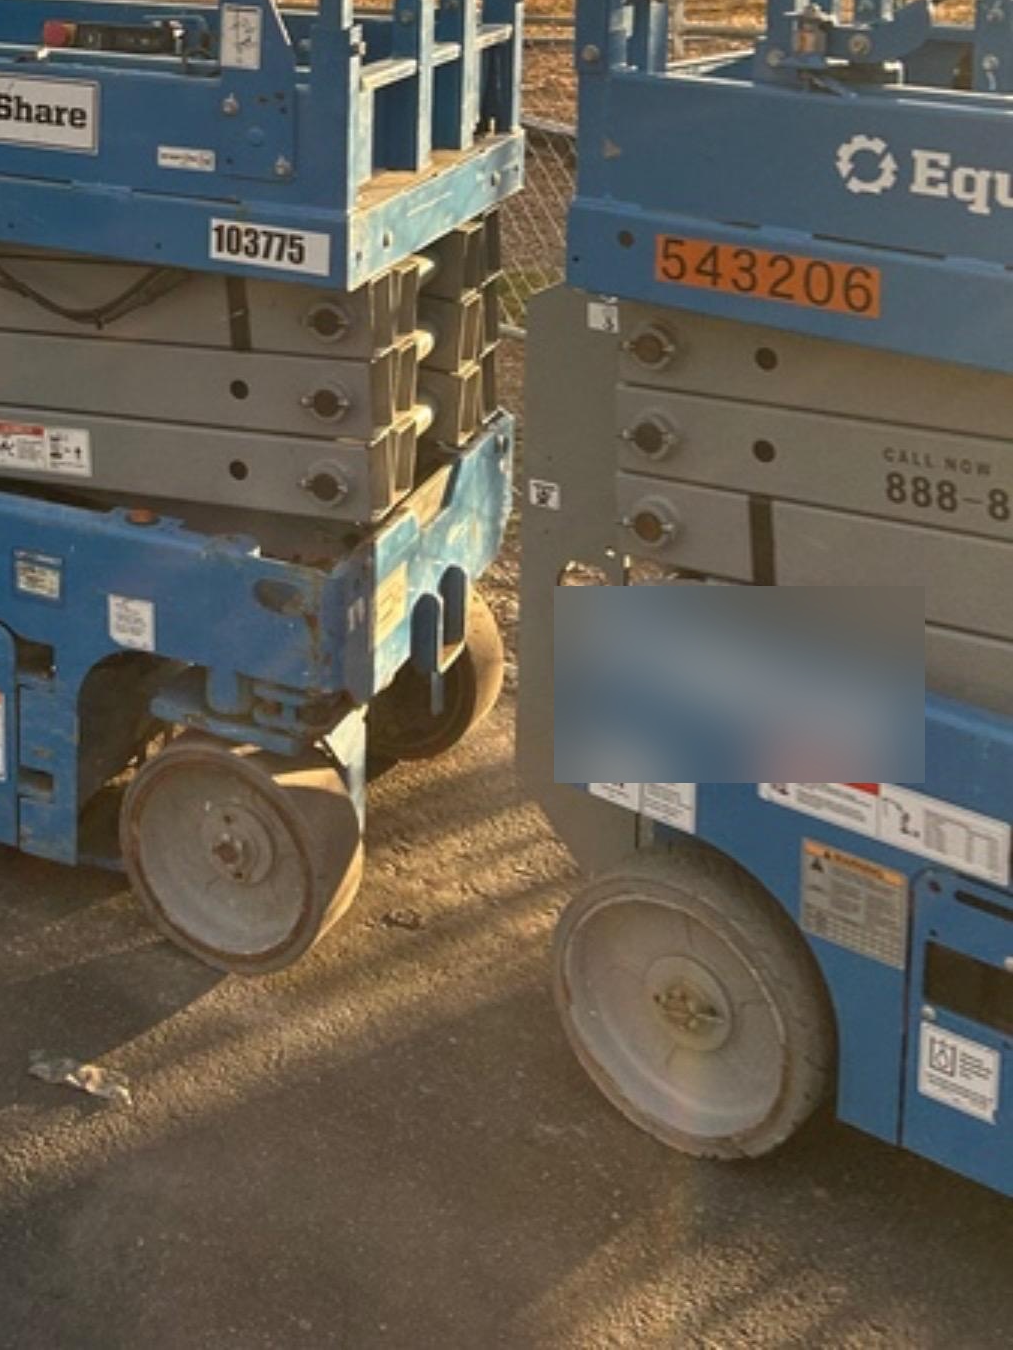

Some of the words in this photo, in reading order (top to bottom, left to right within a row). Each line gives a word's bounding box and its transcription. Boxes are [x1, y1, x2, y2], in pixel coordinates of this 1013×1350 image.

[212, 223, 305, 265] 103775
[661, 238, 873, 313] 543206
[884, 447, 934, 468] CALL
[944, 455, 991, 477] NOW
[886, 471, 1010, 521] 888-8
